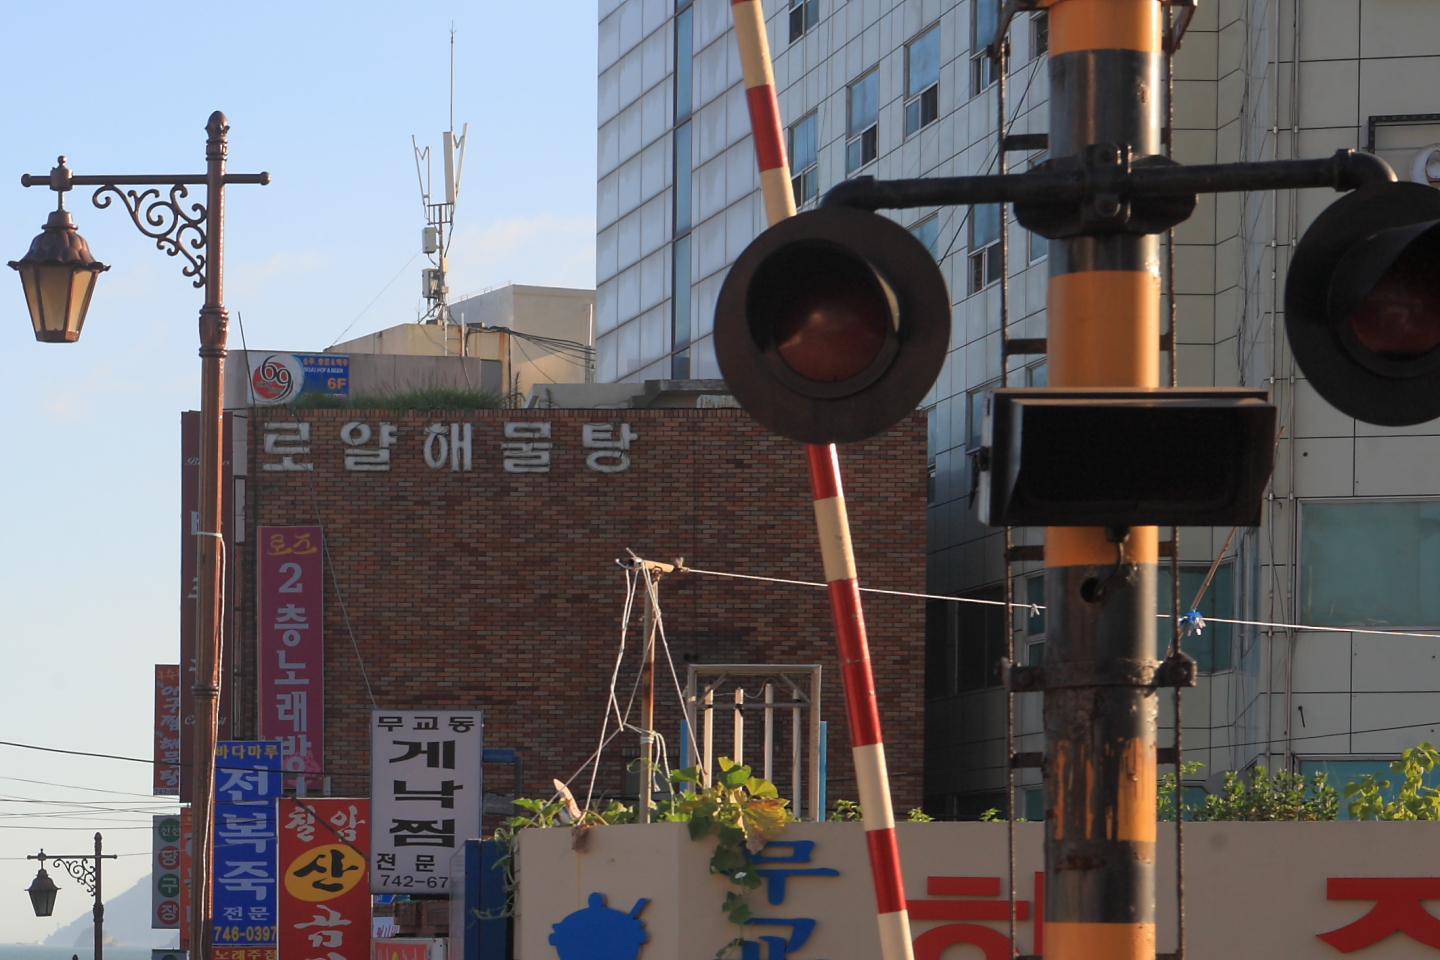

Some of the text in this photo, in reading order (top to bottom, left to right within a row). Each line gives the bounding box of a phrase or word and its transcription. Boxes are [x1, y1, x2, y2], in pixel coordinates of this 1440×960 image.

[327, 377, 346, 390] 6F
[267, 533, 318, 556] 로즈
[377, 716, 476, 732] 무교동
[215, 744, 279, 760] 바다마루
[388, 739, 464, 848] 게낙찜
[218, 765, 275, 901] 전복죽
[376, 852, 436, 872] 전문
[292, 849, 359, 892] 산
[381, 874, 449, 889] 742-67
[223, 906, 270, 921] 전문
[214, 926, 277, 942] 746-0397
